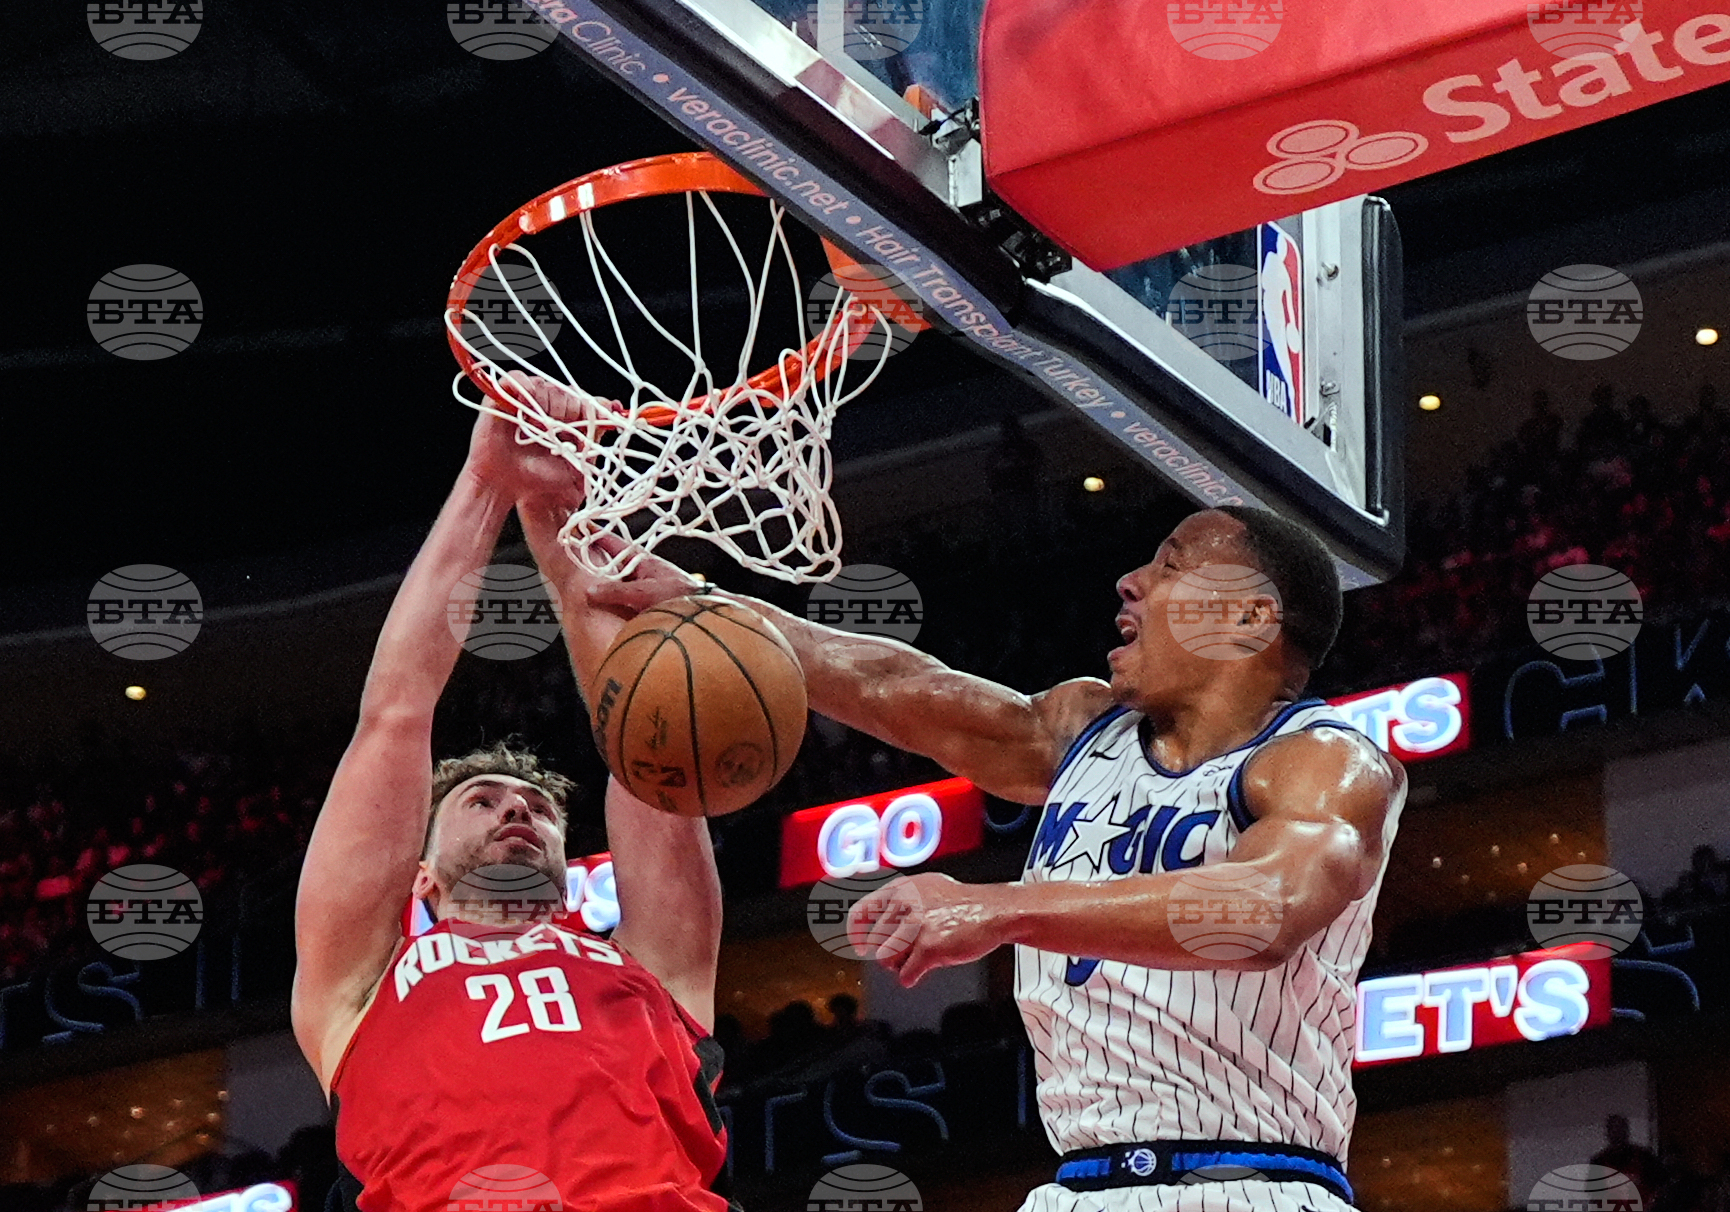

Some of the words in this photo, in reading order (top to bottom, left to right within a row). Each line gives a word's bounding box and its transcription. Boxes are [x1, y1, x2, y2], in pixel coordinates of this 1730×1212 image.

[572, 20, 646, 75] Clinic
[1423, 13, 1730, 143] State
[667, 87, 849, 215] veraclinic.net
[856, 224, 922, 266] Hair
[914, 258, 1042, 361] Transplant
[1037, 355, 1114, 410] Turkey
[818, 793, 943, 879] GO
[394, 923, 624, 1003] ROCKETS
[465, 966, 582, 1043] 28
[1355, 958, 1590, 1062] ET'S
